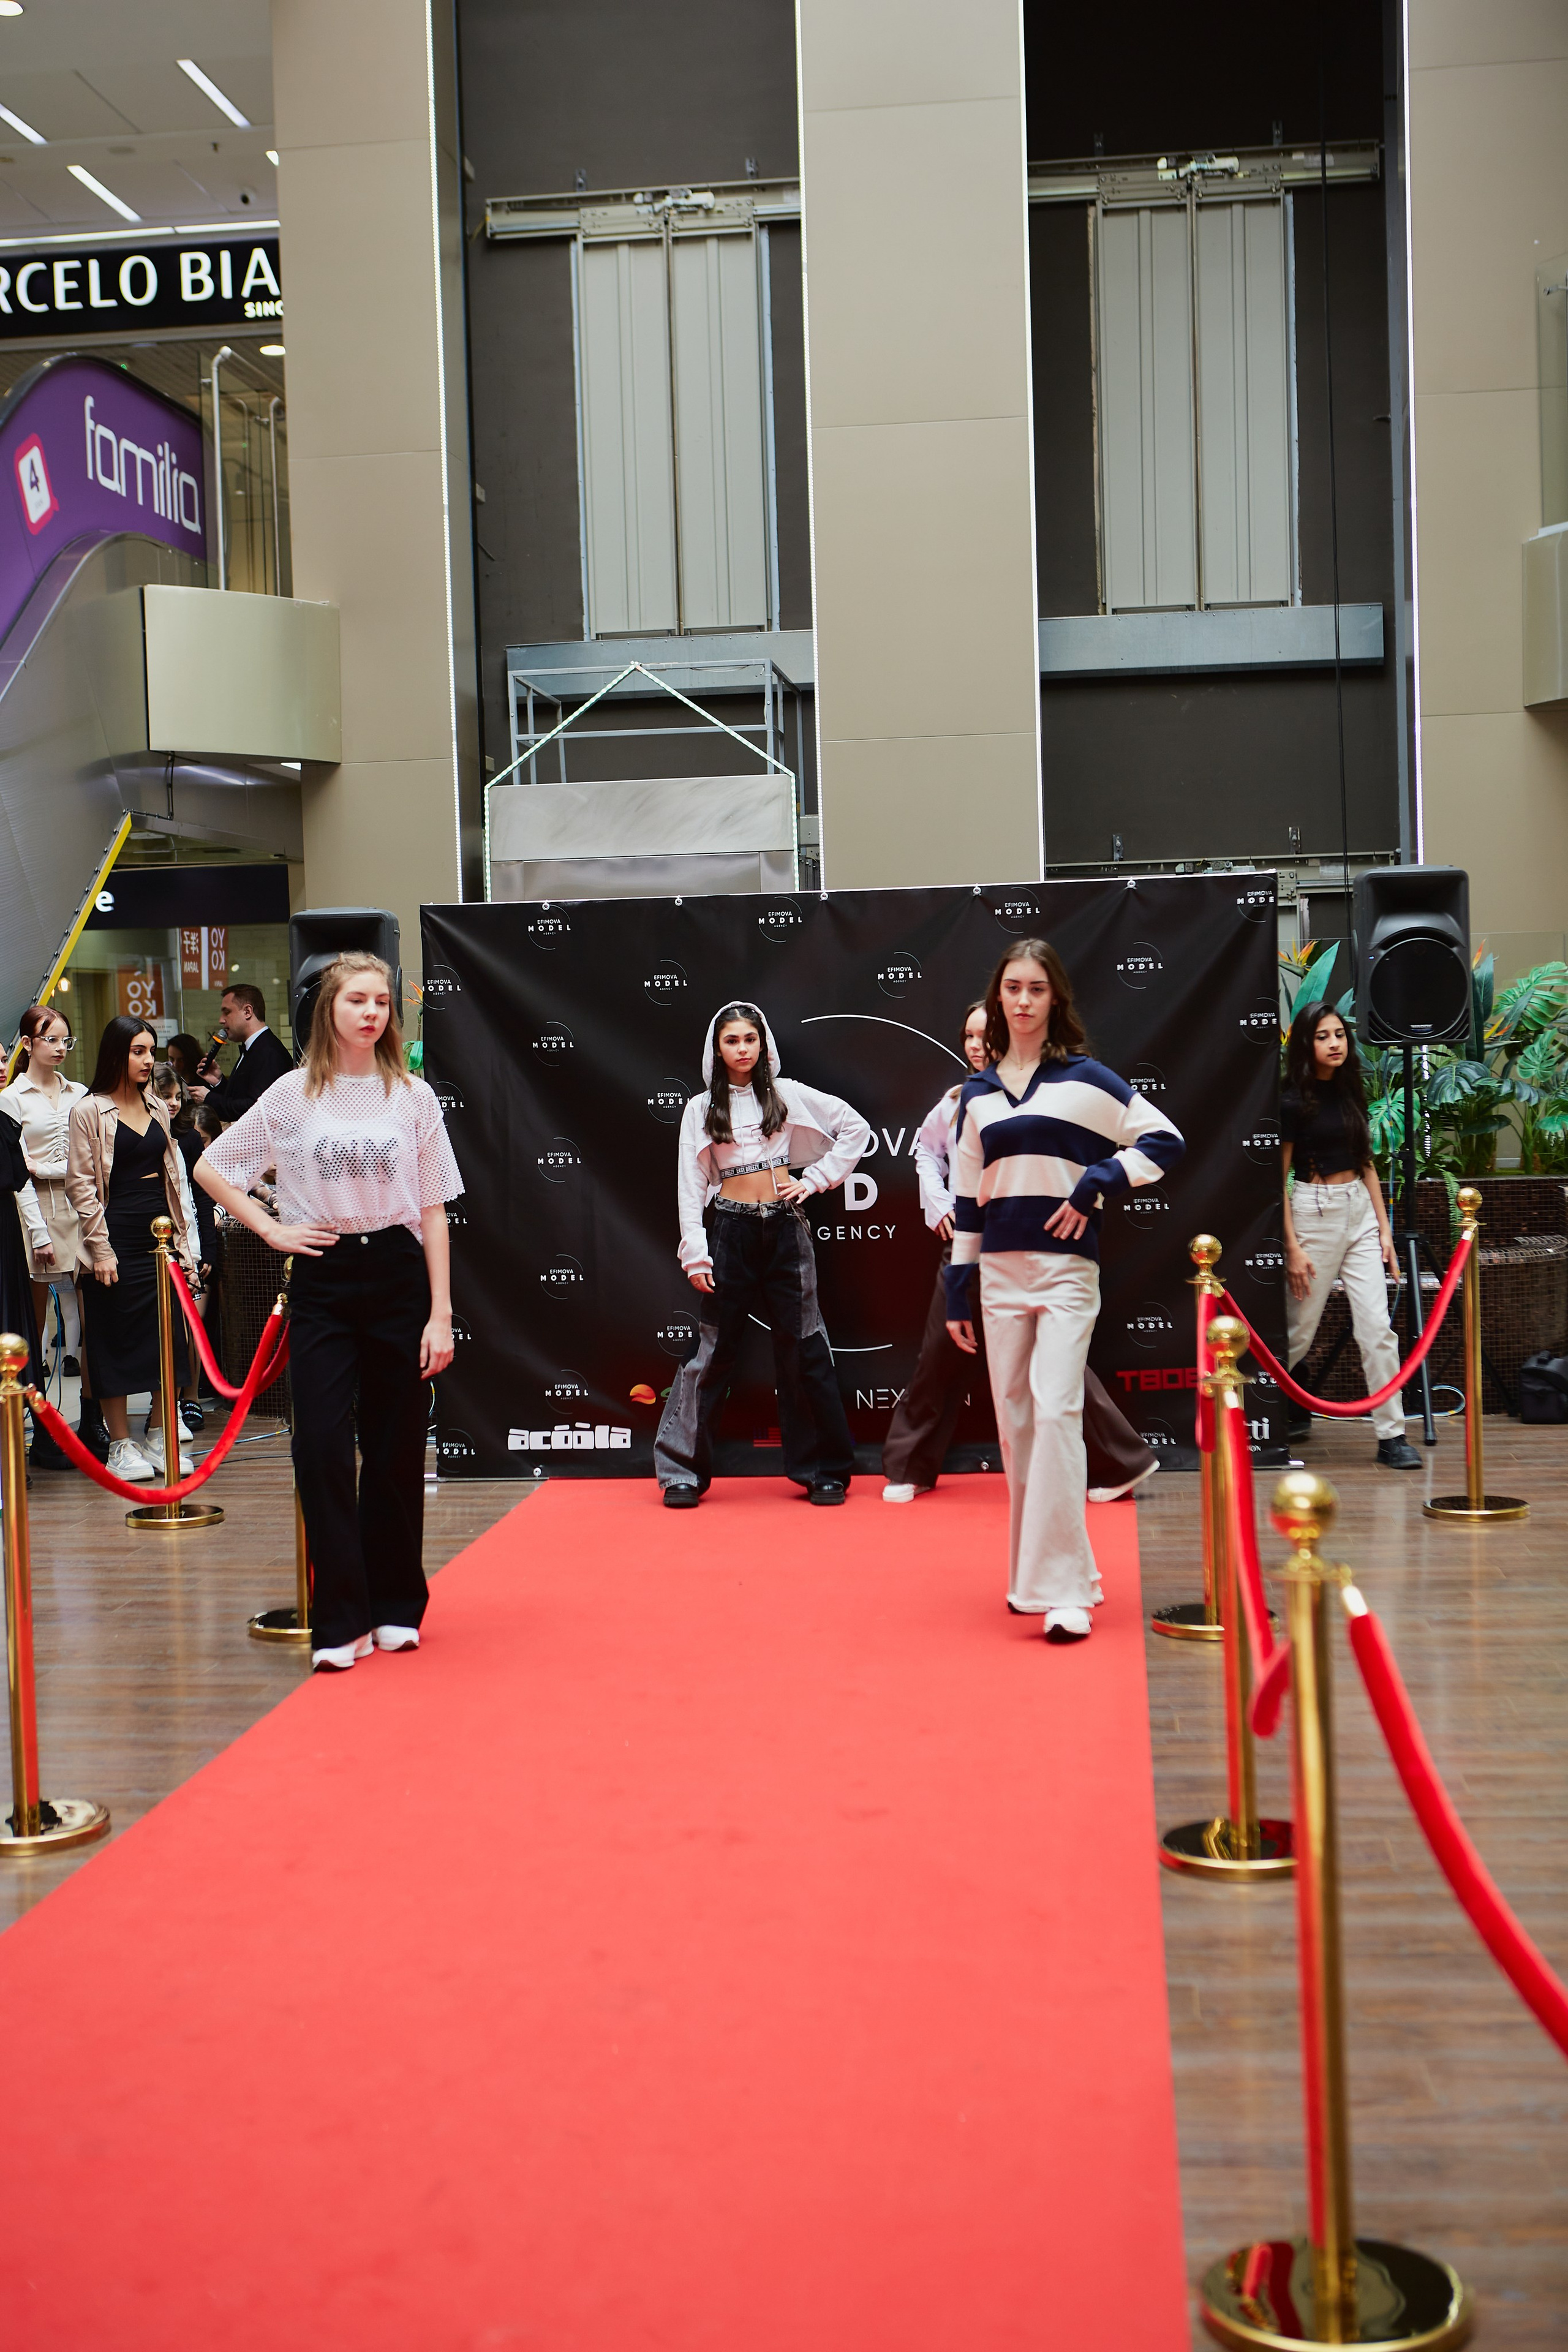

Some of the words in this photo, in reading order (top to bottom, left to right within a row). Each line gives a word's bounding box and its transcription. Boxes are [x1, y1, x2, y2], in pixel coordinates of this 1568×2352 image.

[179, 247, 281, 302] BIA
[244, 300, 284, 318] SINC
[84, 395, 201, 535] familia
[1117, 962, 1163, 971] MODEL
[817, 1225, 895, 1240] GENCY
[856, 1389, 905, 1409] NEX
